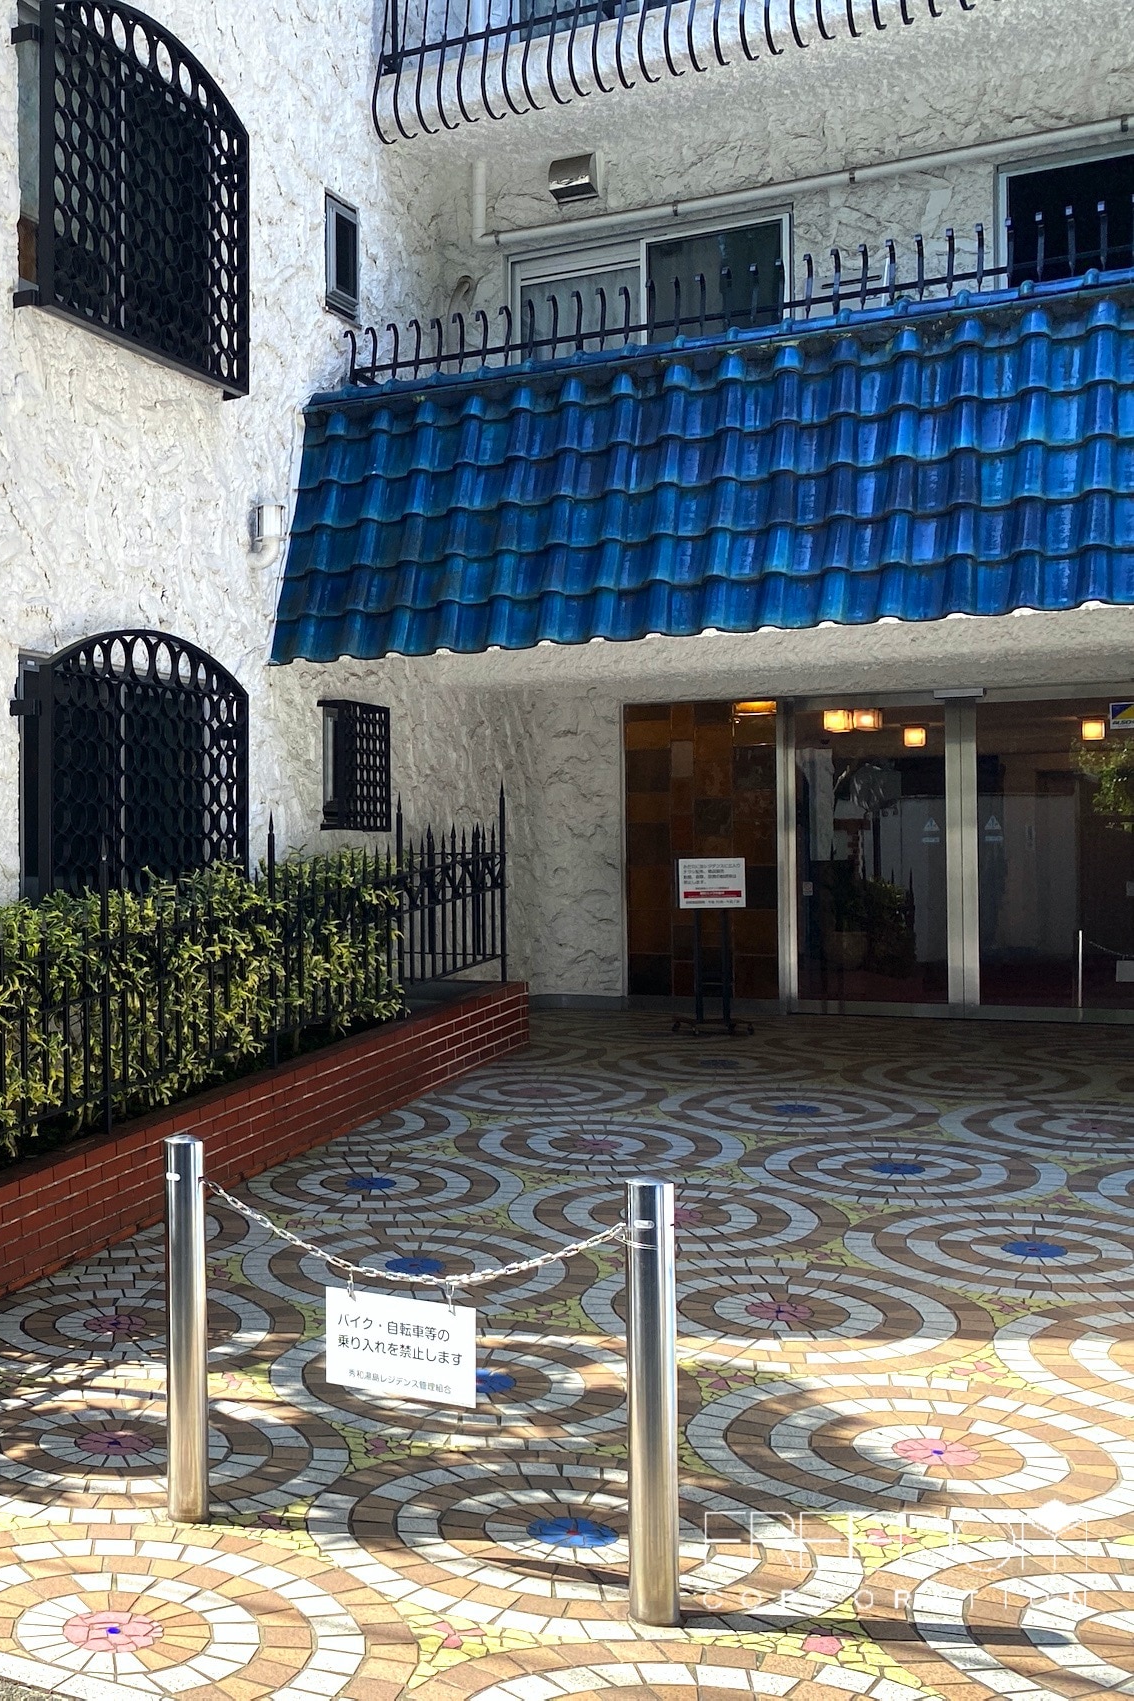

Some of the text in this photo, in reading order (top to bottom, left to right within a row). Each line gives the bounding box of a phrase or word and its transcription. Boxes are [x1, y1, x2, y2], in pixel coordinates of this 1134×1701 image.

[338, 1314, 450, 1342] バイク・自転車等の
[338, 1334, 463, 1366] 乗り入れを禁止します
[348, 1368, 452, 1395] 秀和湯島レジデンス管理組合
